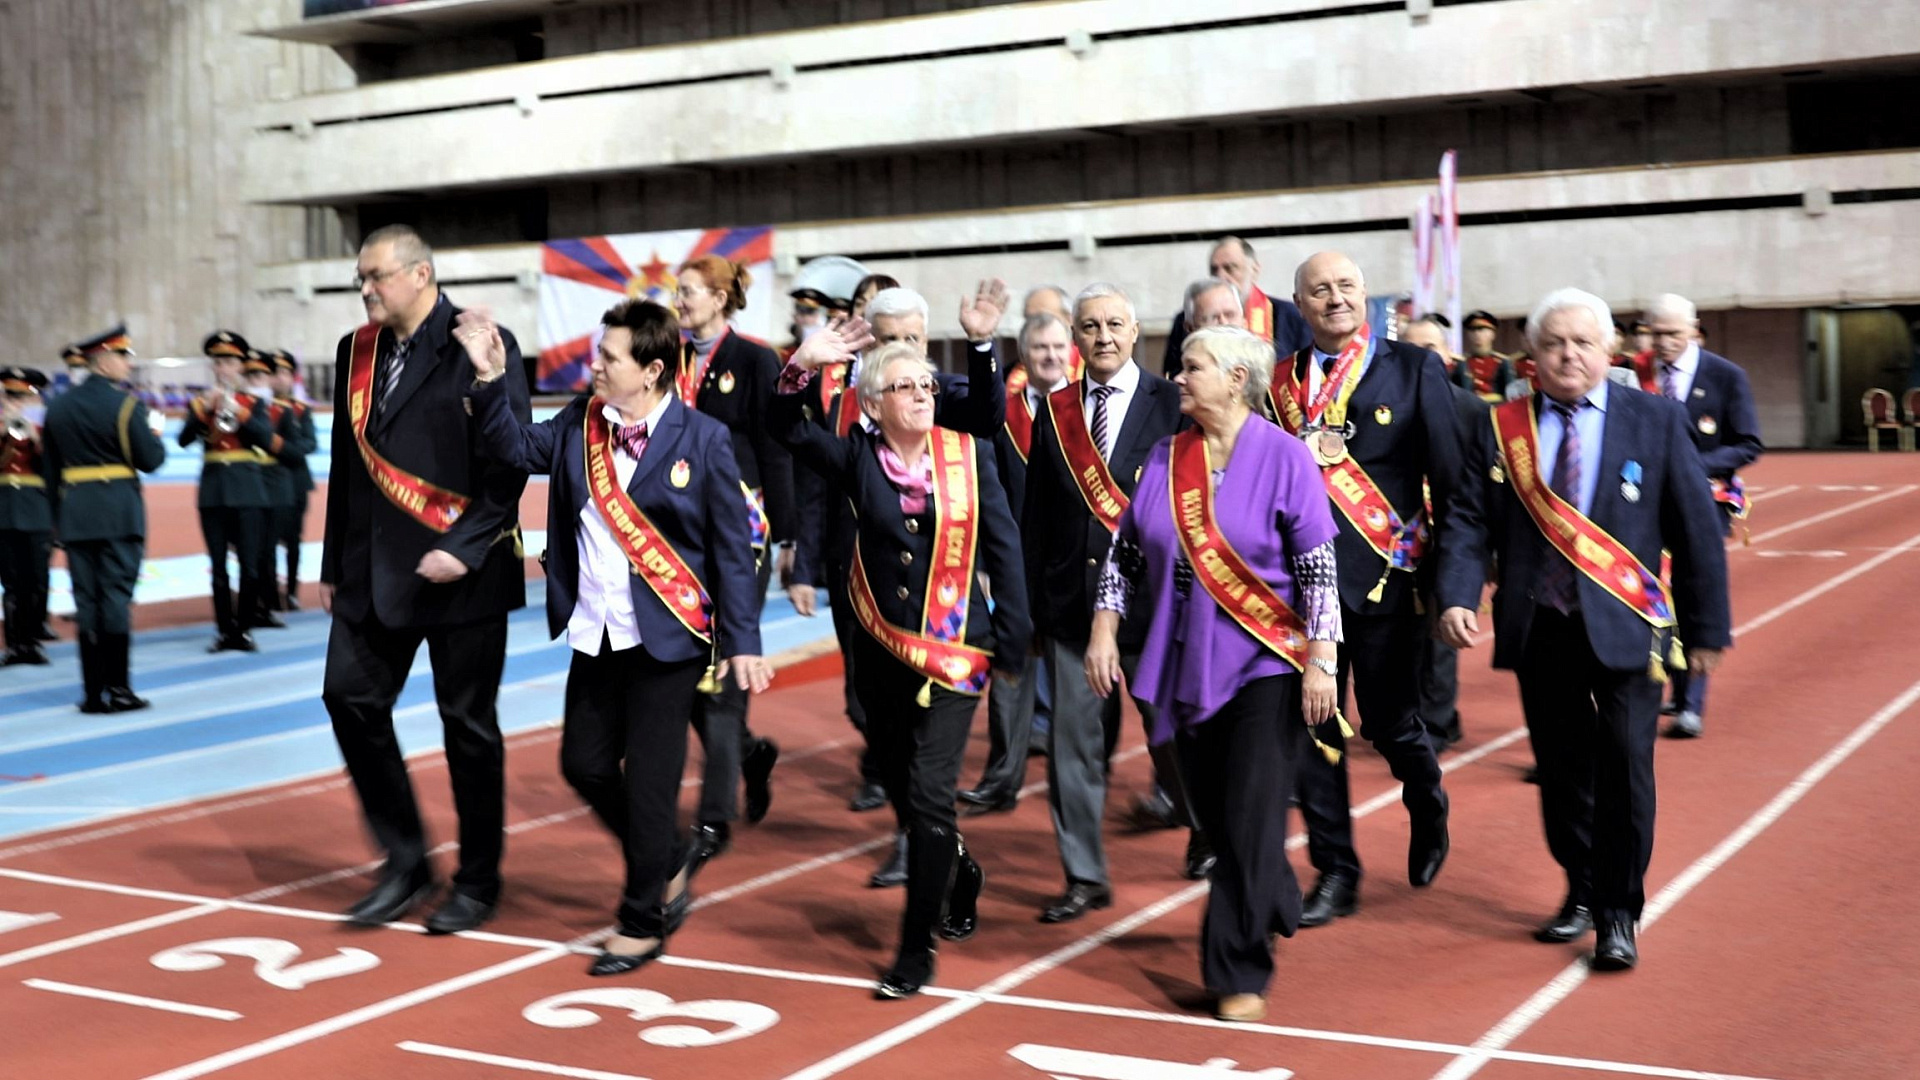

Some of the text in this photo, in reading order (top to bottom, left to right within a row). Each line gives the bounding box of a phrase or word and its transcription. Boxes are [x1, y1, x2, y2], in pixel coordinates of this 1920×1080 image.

[1083, 464, 1122, 519] ВЕТЕРАН
[605, 497, 649, 550] СПОРТА
[149, 936, 382, 990] 2
[520, 987, 781, 1048] 3
